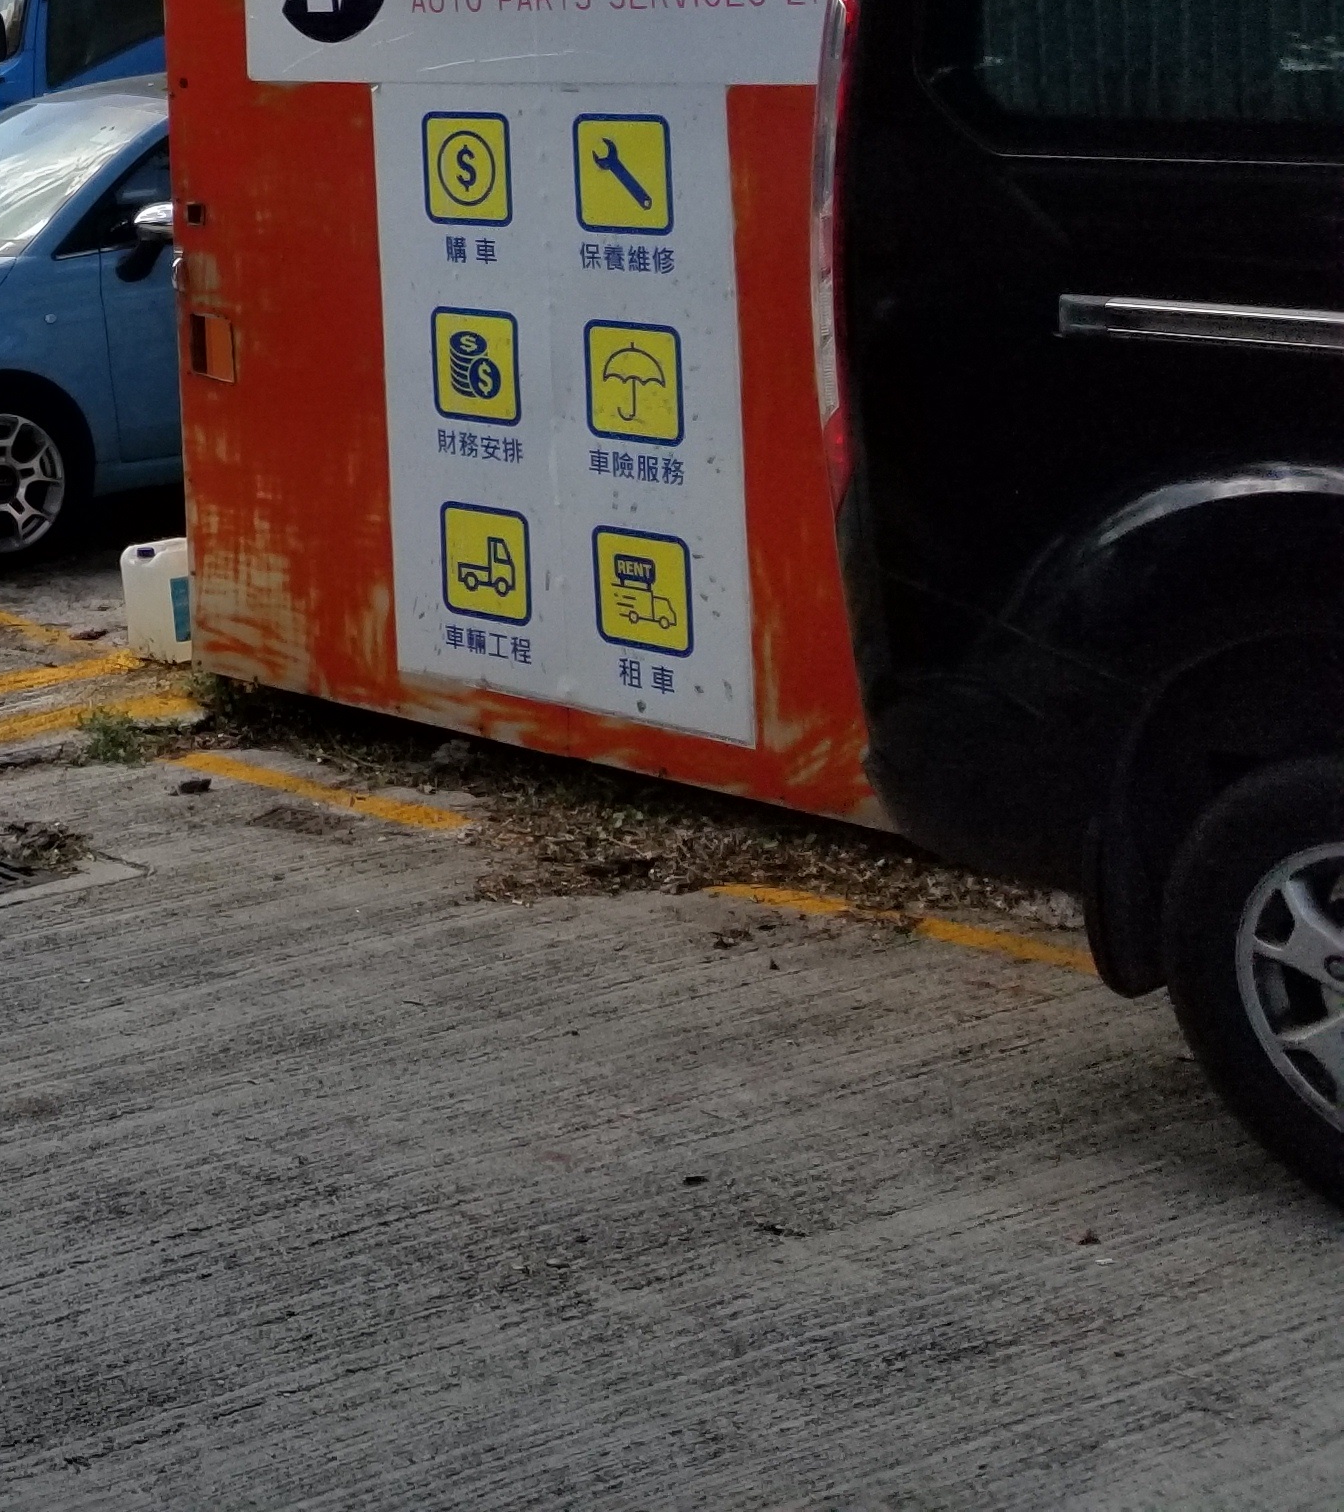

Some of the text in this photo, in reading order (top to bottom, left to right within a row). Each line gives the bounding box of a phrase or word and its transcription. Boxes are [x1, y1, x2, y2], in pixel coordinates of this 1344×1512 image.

[445, 235, 498, 265] 購車
[579, 241, 675, 275] 保養維修
[437, 428, 524, 465] 財務安排
[588, 448, 685, 487] 車險服務
[617, 557, 652, 579] RENT
[445, 623, 533, 666] 車輛工程
[618, 656, 676, 694] 租車
